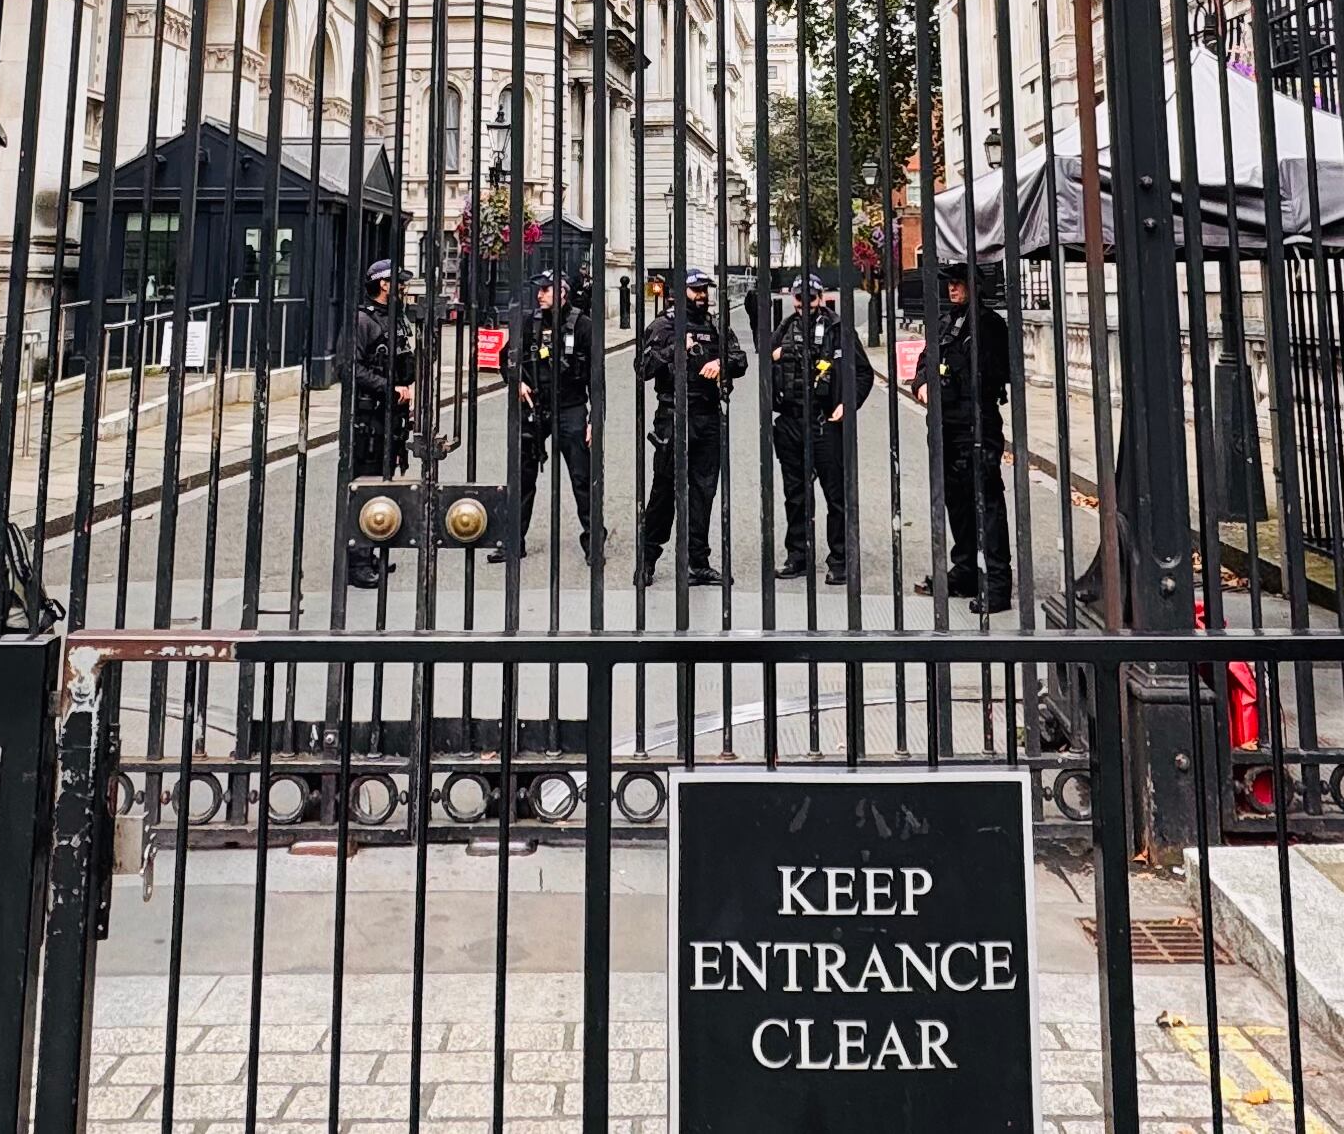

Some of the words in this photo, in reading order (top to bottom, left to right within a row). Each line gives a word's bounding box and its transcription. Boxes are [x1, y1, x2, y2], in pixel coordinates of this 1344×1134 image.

[776, 865, 933, 916] KEEP
[689, 940, 1018, 993] ENTRANCE
[751, 1018, 959, 1071] CLEAR
